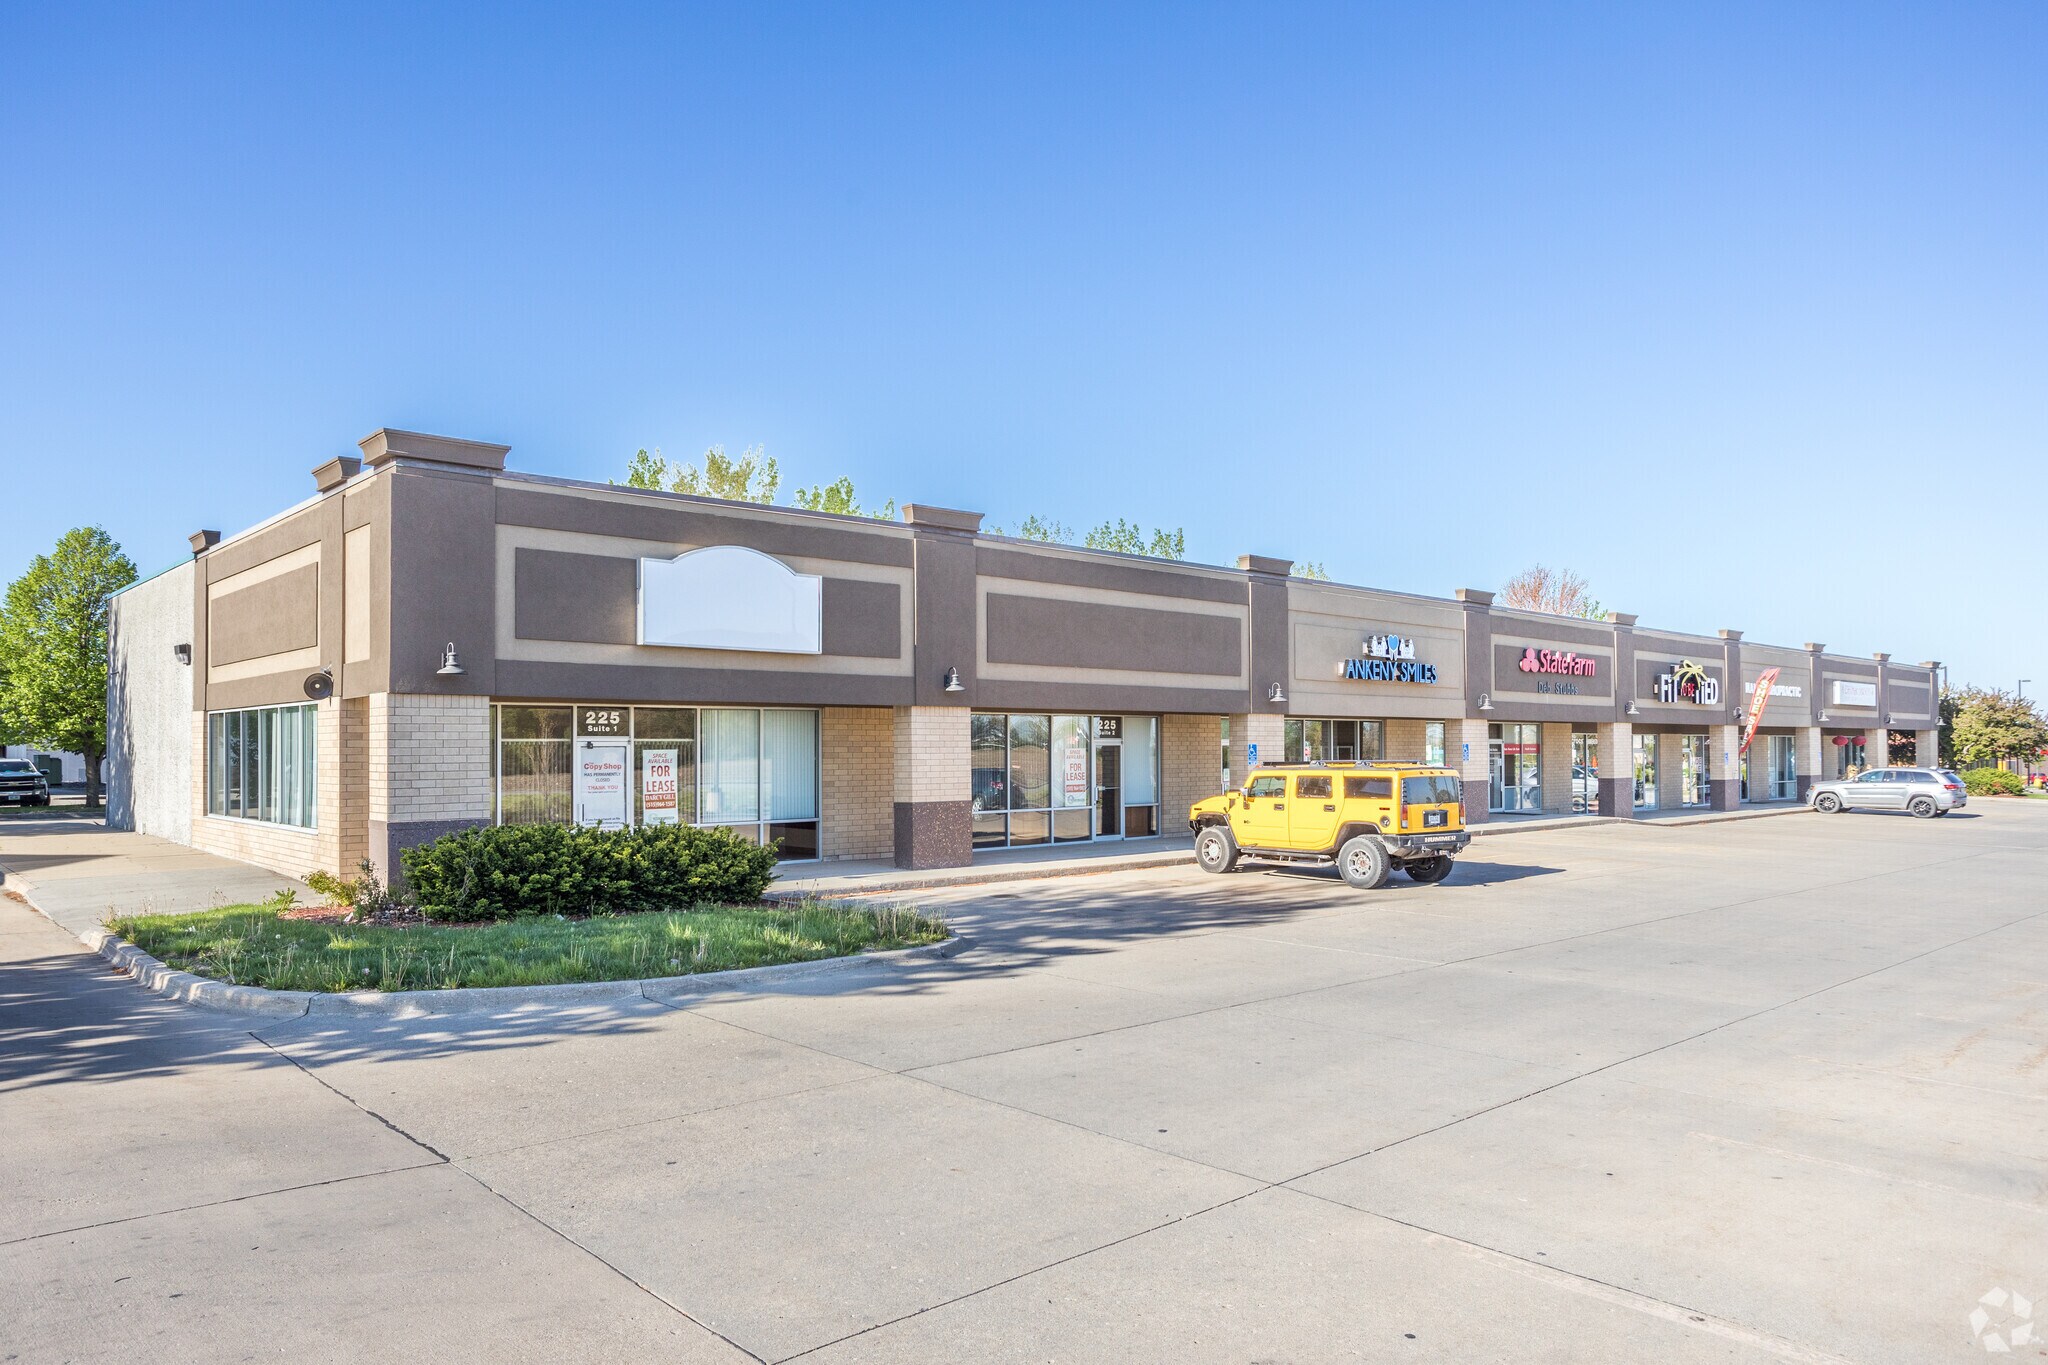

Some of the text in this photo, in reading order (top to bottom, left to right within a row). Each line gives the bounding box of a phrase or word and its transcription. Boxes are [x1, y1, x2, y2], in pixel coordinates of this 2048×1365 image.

[1345, 659, 1438, 684] ANKENY SMILES
[1538, 681, 1579, 695] Deb Stubbs
[585, 711, 620, 724] 225
[1741, 679, 1769, 748] SHOE SALE
[1098, 720, 1117, 730] 225
[603, 762, 622, 770] Shop
[651, 765, 670, 777] FOR
[1069, 763, 1082, 771] FOR
[1066, 772, 1086, 781] LEASE
[646, 780, 675, 793] LEASE
[1424, 835, 1457, 843] HUMMER
